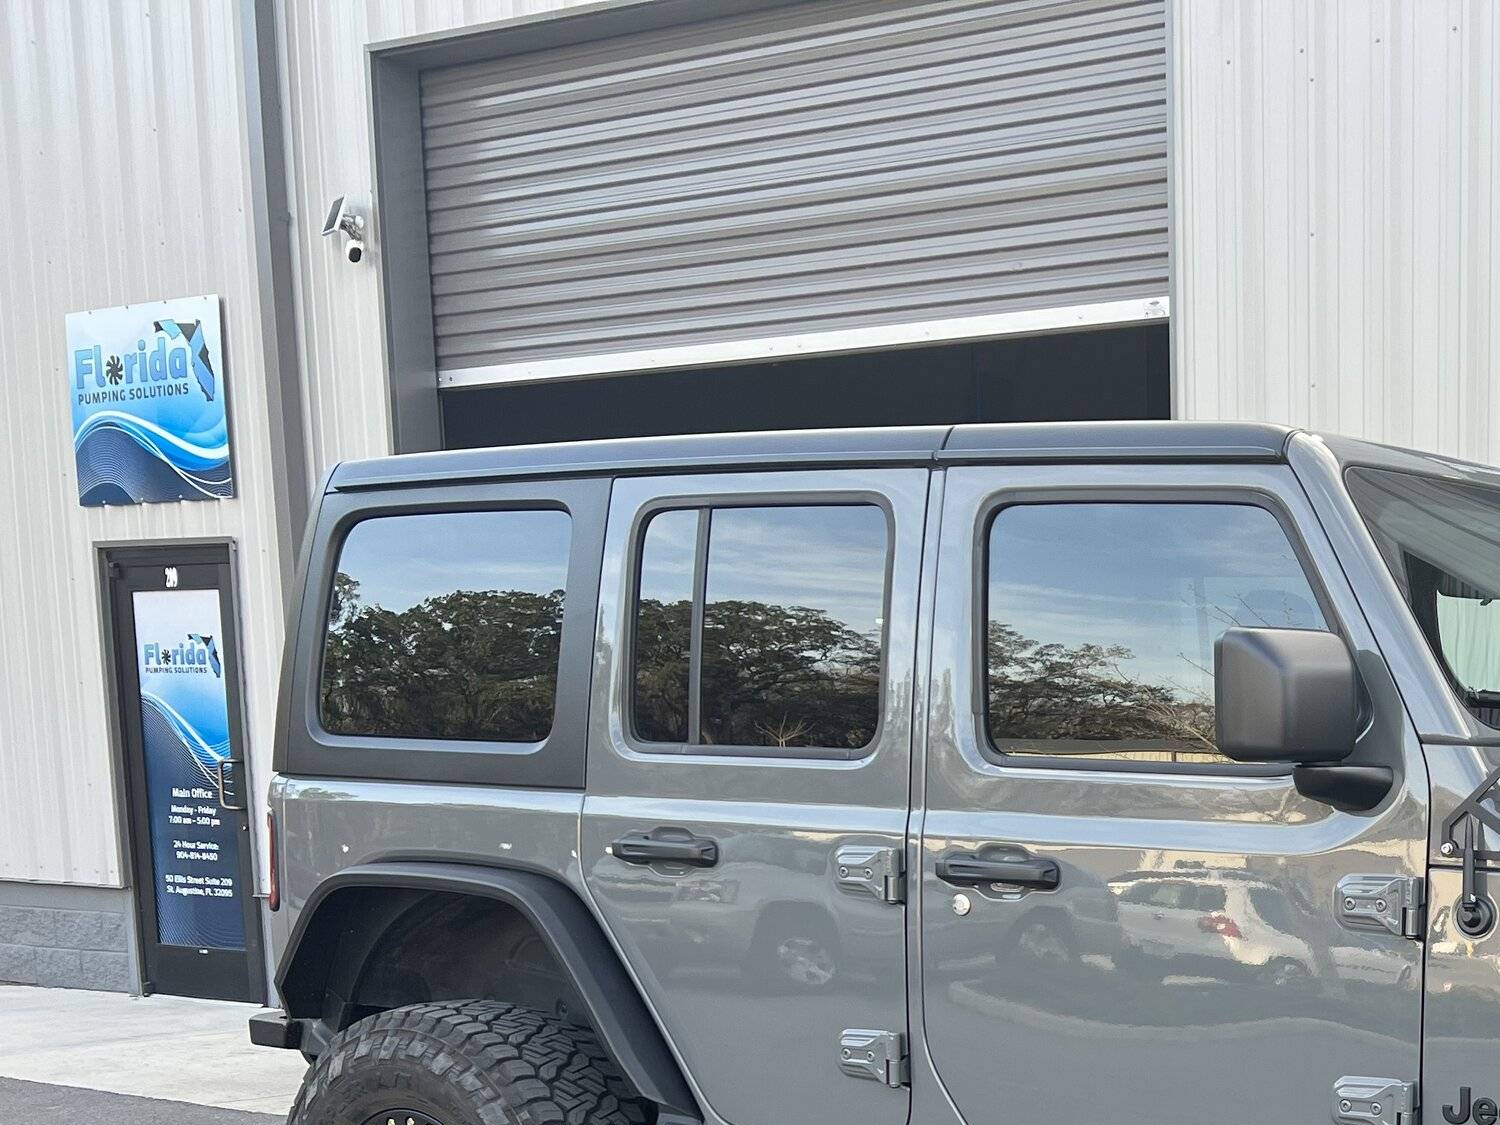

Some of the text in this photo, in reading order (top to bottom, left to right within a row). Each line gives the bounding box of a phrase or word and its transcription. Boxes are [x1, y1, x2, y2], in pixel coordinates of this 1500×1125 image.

[78, 382, 189, 405] PUMPING SOLUTIONS
[174, 666, 207, 674] SOLUTIONS
[172, 788, 213, 798] Main Office
[171, 805, 194, 815] Monday
[198, 806, 217, 816] Friday
